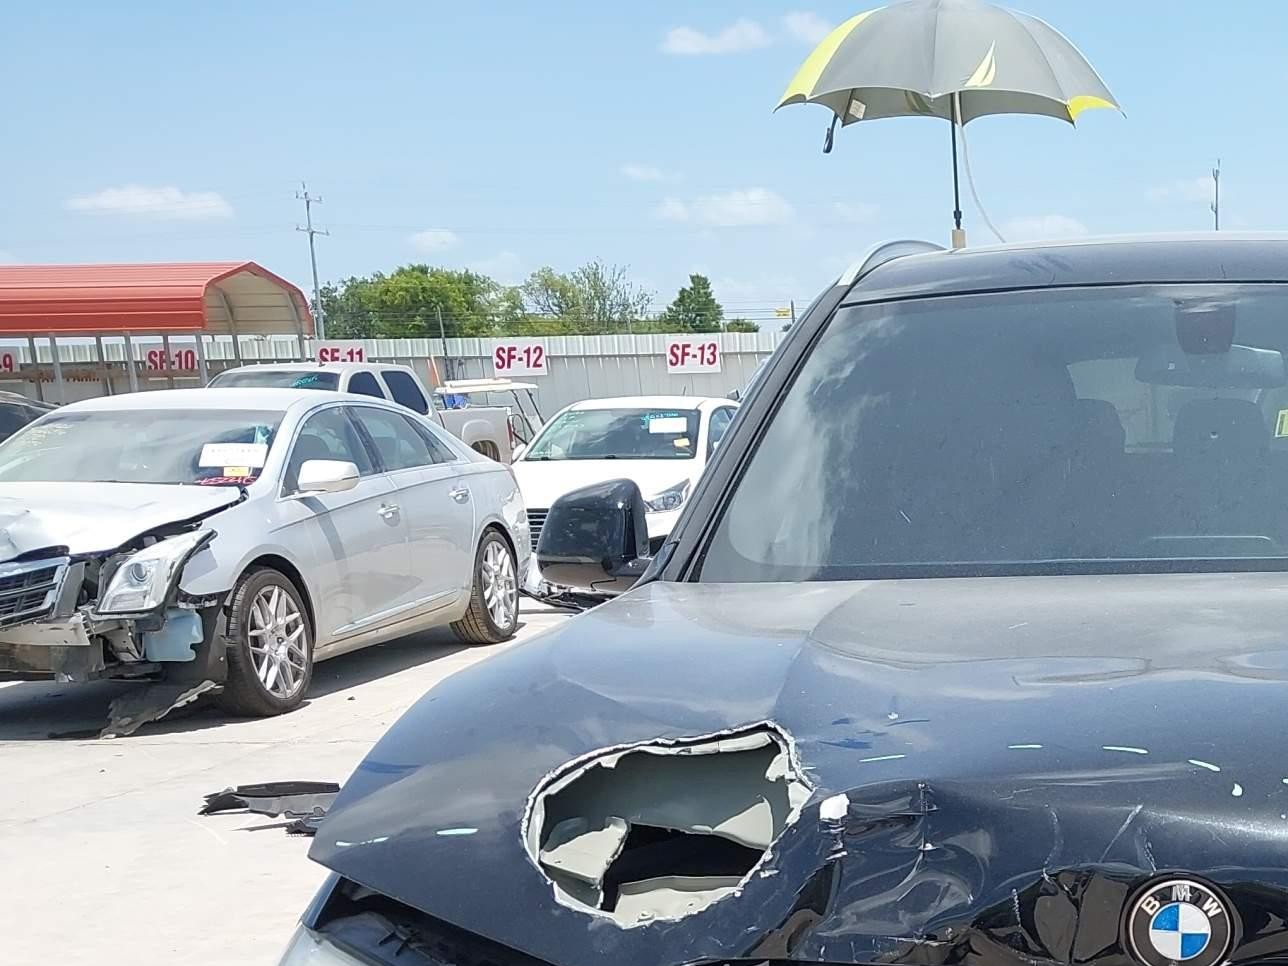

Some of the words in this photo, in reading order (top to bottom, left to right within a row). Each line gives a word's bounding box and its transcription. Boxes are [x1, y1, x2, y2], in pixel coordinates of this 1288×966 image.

[495, 346, 543, 370] SF-12
[669, 342, 718, 368] SF-13
[1141, 883, 1222, 918] BMW
